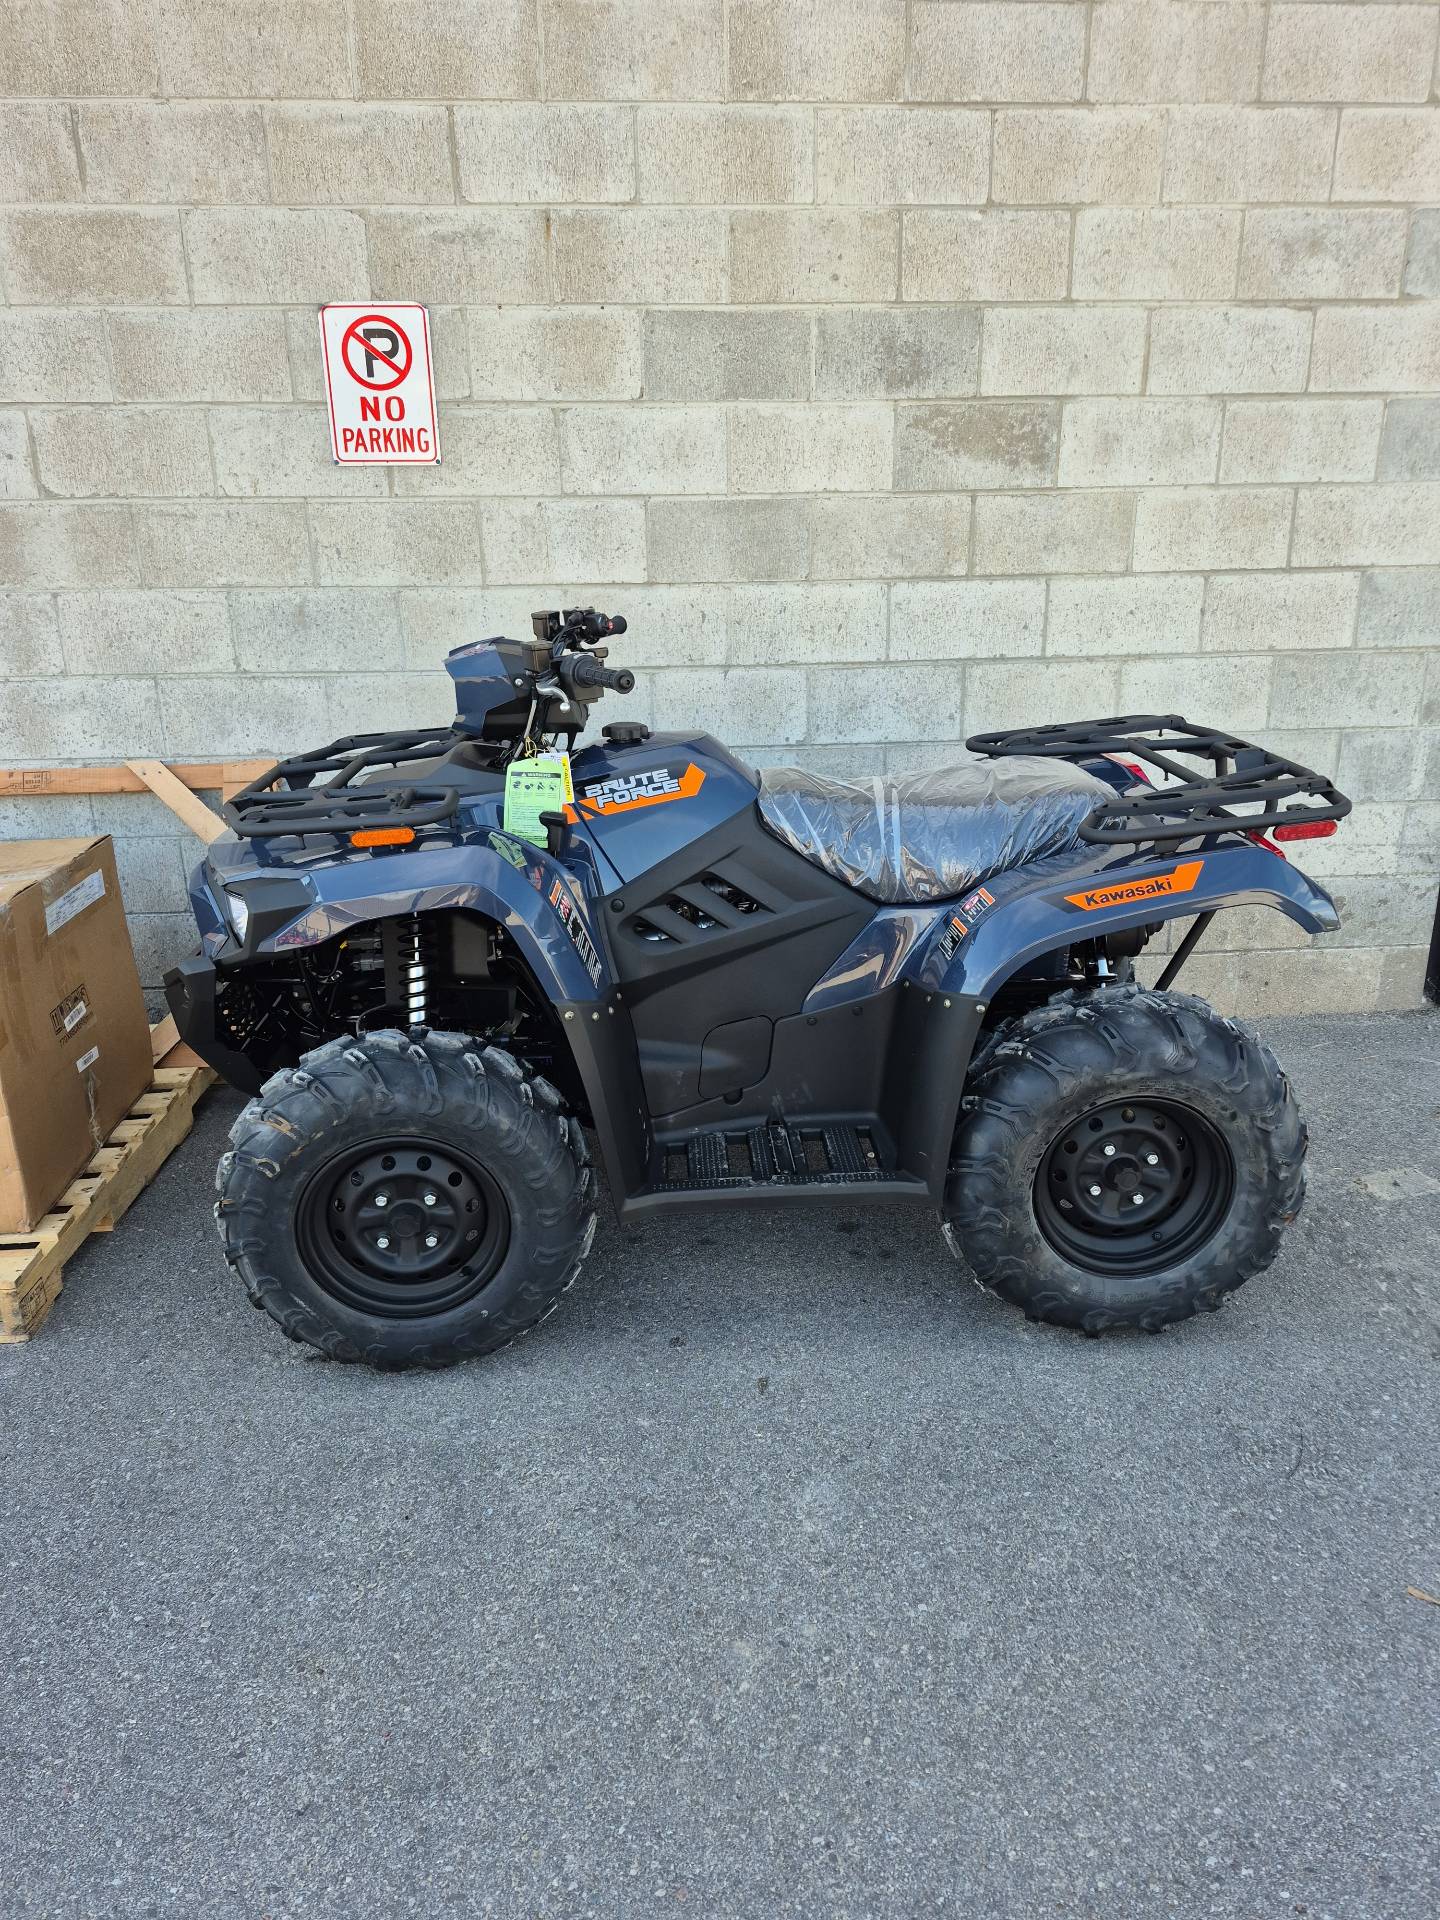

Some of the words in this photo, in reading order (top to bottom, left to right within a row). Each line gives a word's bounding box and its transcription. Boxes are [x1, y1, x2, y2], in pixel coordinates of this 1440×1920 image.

[362, 328, 400, 378] P
[360, 396, 406, 422] NO
[342, 427, 430, 453] PARKING
[584, 768, 671, 798] BRUTE
[596, 778, 681, 808] FORCE
[1084, 877, 1173, 906] Kawasaki
